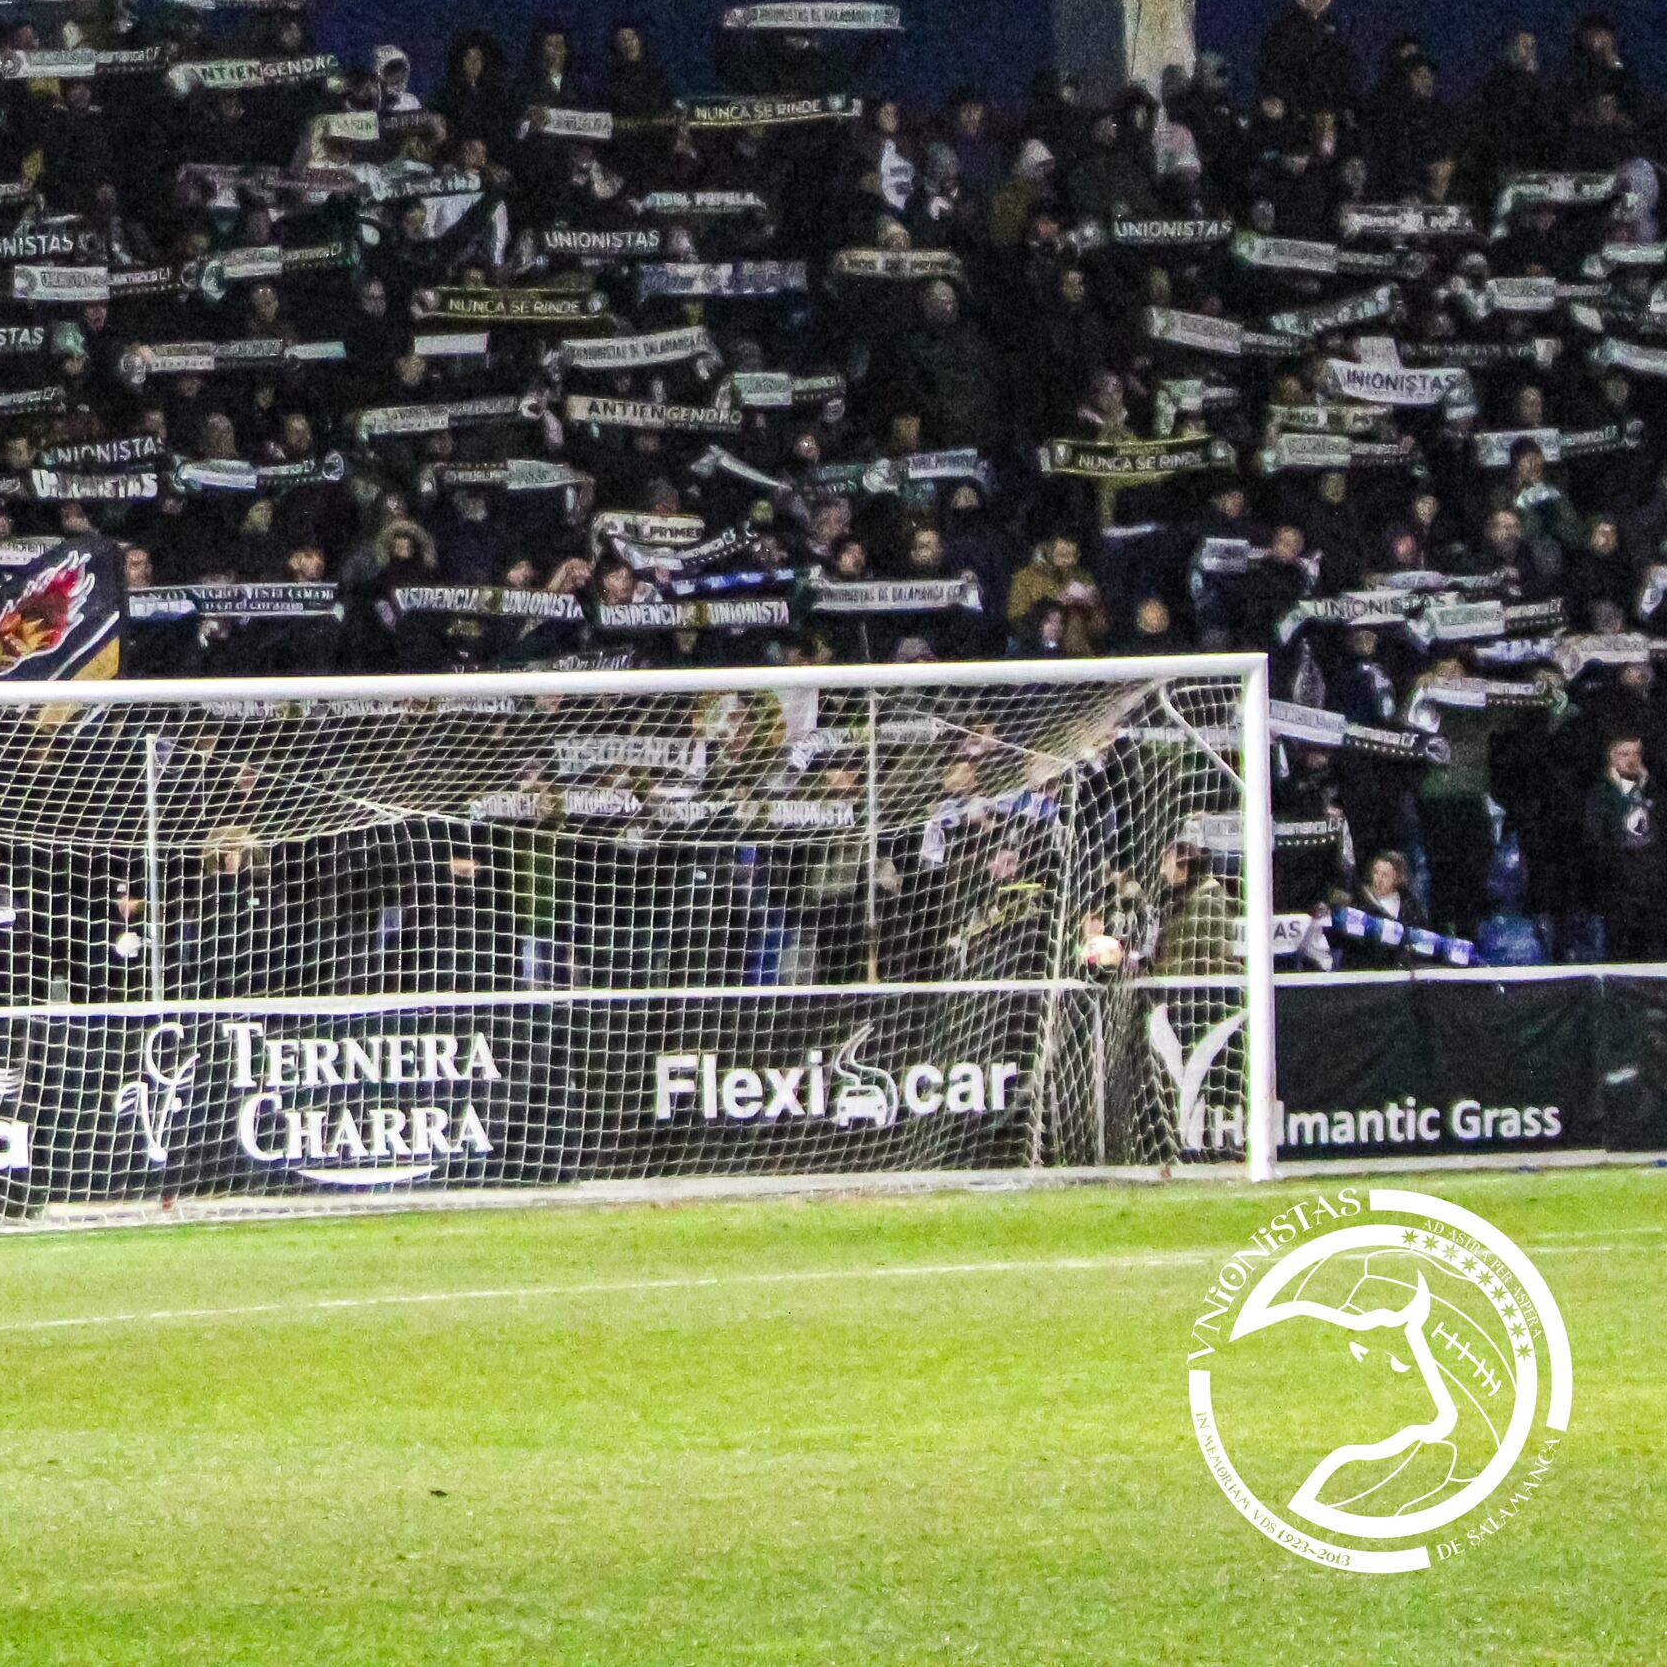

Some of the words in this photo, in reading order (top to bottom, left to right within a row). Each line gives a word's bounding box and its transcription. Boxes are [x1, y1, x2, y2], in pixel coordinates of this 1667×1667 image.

[695, 106, 749, 121] NUNCA
[751, 104, 772, 119] SE
[776, 99, 822, 116] RINDE
[544, 230, 660, 249] UNIONISTAS
[1115, 221, 1234, 238] UNIONISTAS
[449, 298, 506, 314] NUNCA
[510, 299, 530, 315] SE
[533, 299, 581, 314] RINDE
[1345, 369, 1458, 392] UNIONISTAS
[588, 398, 744, 425] ANTIENGENDRO
[1078, 455, 1133, 472] NUNCA
[601, 603, 684, 627] DISIDENCIA
[710, 602, 790, 625] UNIONISTA
[223, 1022, 502, 1090] TERNERA
[654, 1048, 824, 1120] Flexi
[903, 1061, 1017, 1113] car
[238, 1091, 495, 1162] CHARRA
[1210, 1095, 1440, 1148] Hlmantic
[1452, 1098, 1562, 1139] Grass
